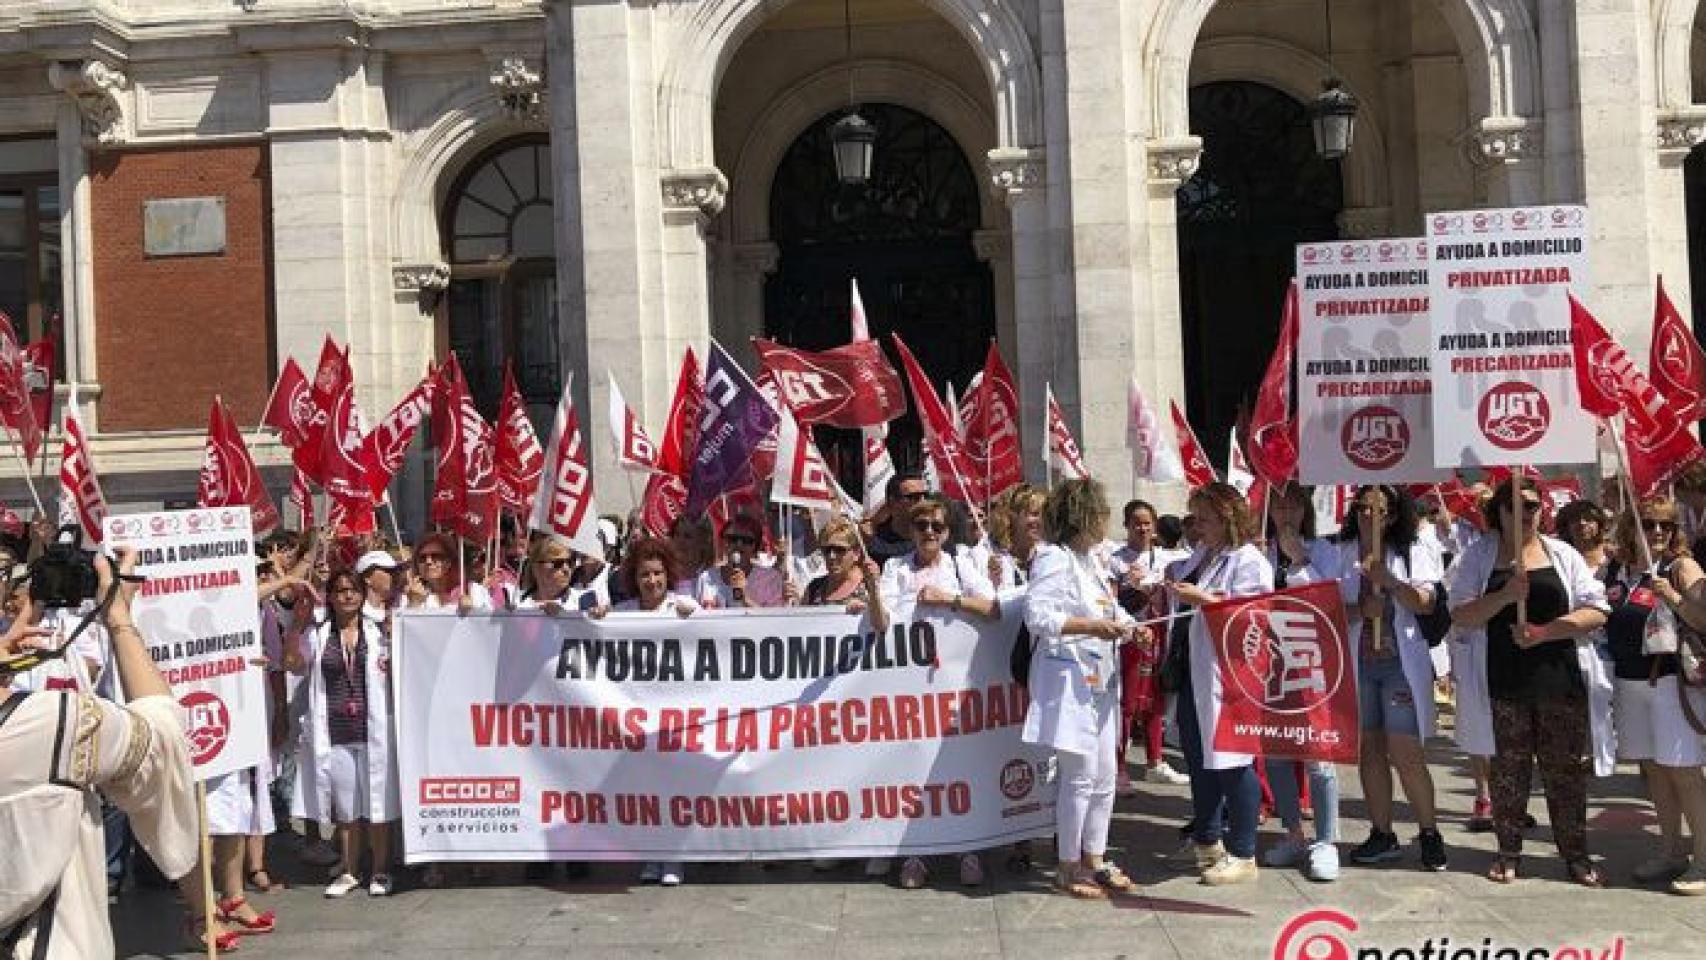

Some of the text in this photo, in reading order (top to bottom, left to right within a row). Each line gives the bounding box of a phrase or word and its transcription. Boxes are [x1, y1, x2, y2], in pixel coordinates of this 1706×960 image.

[1436, 241, 1485, 260] AYUDA
[1488, 241, 1498, 257] A
[1502, 237, 1581, 257] DOMICILIO
[1305, 269, 1429, 289] AYUDA A DOMICIL
[1448, 267, 1571, 289] PRIVATIZADA
[1439, 333, 1488, 350] AYUDA
[1492, 332, 1501, 348] A
[1306, 357, 1430, 375] AYUDA A DOMICIL
[1451, 352, 1571, 373] PRECARIZADA
[1487, 391, 1541, 420] UGT
[1352, 415, 1403, 442] UGT
[166, 545, 177, 563] A
[179, 539, 248, 561] DOMICILIO
[141, 569, 240, 596] RIVATIZADA
[174, 642, 184, 659] A
[186, 630, 255, 656] DOMICILIO
[556, 619, 937, 682] AYUDA A DOMICILIO
[1269, 611, 1327, 694] UGT
[470, 682, 1030, 752] VICTIMAS DE LA PRECARIEDAD
[1235, 724, 1339, 745] www.ugt.es
[426, 783, 492, 799] CCOO
[541, 790, 608, 824] POR
[616, 793, 662, 826] UN
[670, 790, 849, 828] CONVENIO
[860, 780, 971, 819] JUSTO
[436, 822, 518, 833] servicios
